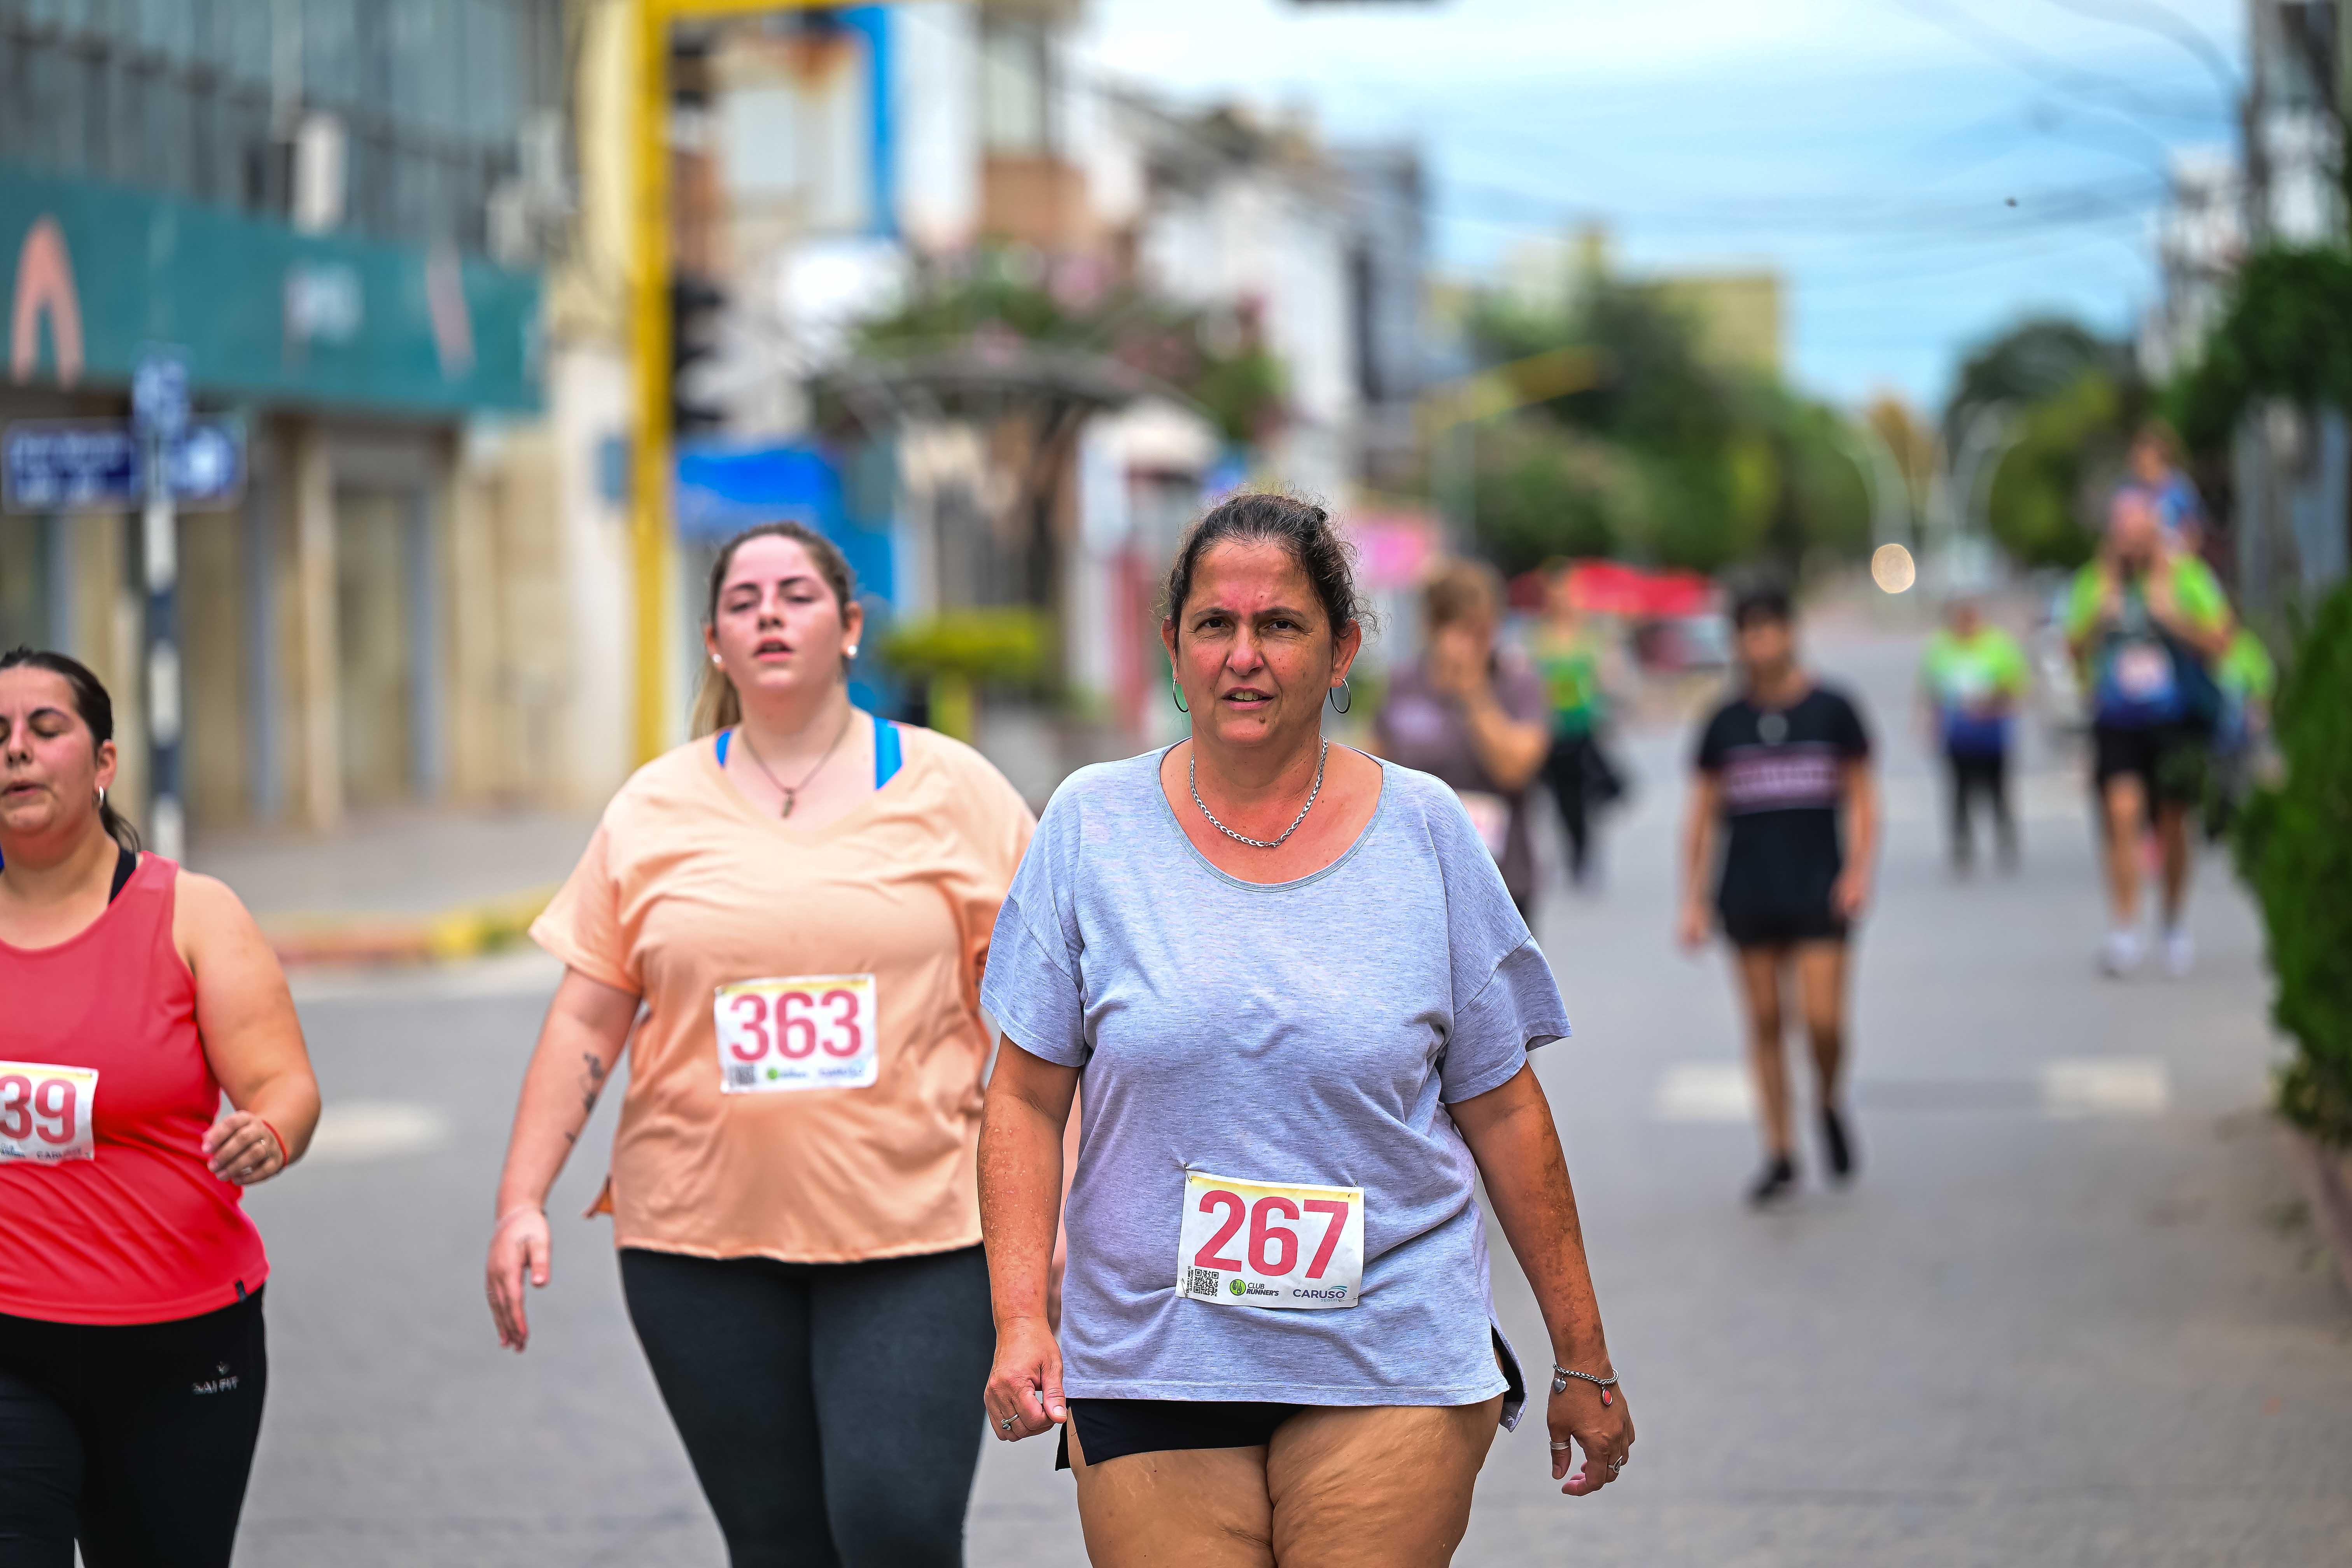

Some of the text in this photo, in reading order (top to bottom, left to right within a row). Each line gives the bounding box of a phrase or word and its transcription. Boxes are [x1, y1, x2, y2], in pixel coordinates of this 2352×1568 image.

[730, 989, 862, 1062] 363
[1194, 1190, 1348, 1279] 267
[1293, 1289, 1345, 1298] CARUSO
